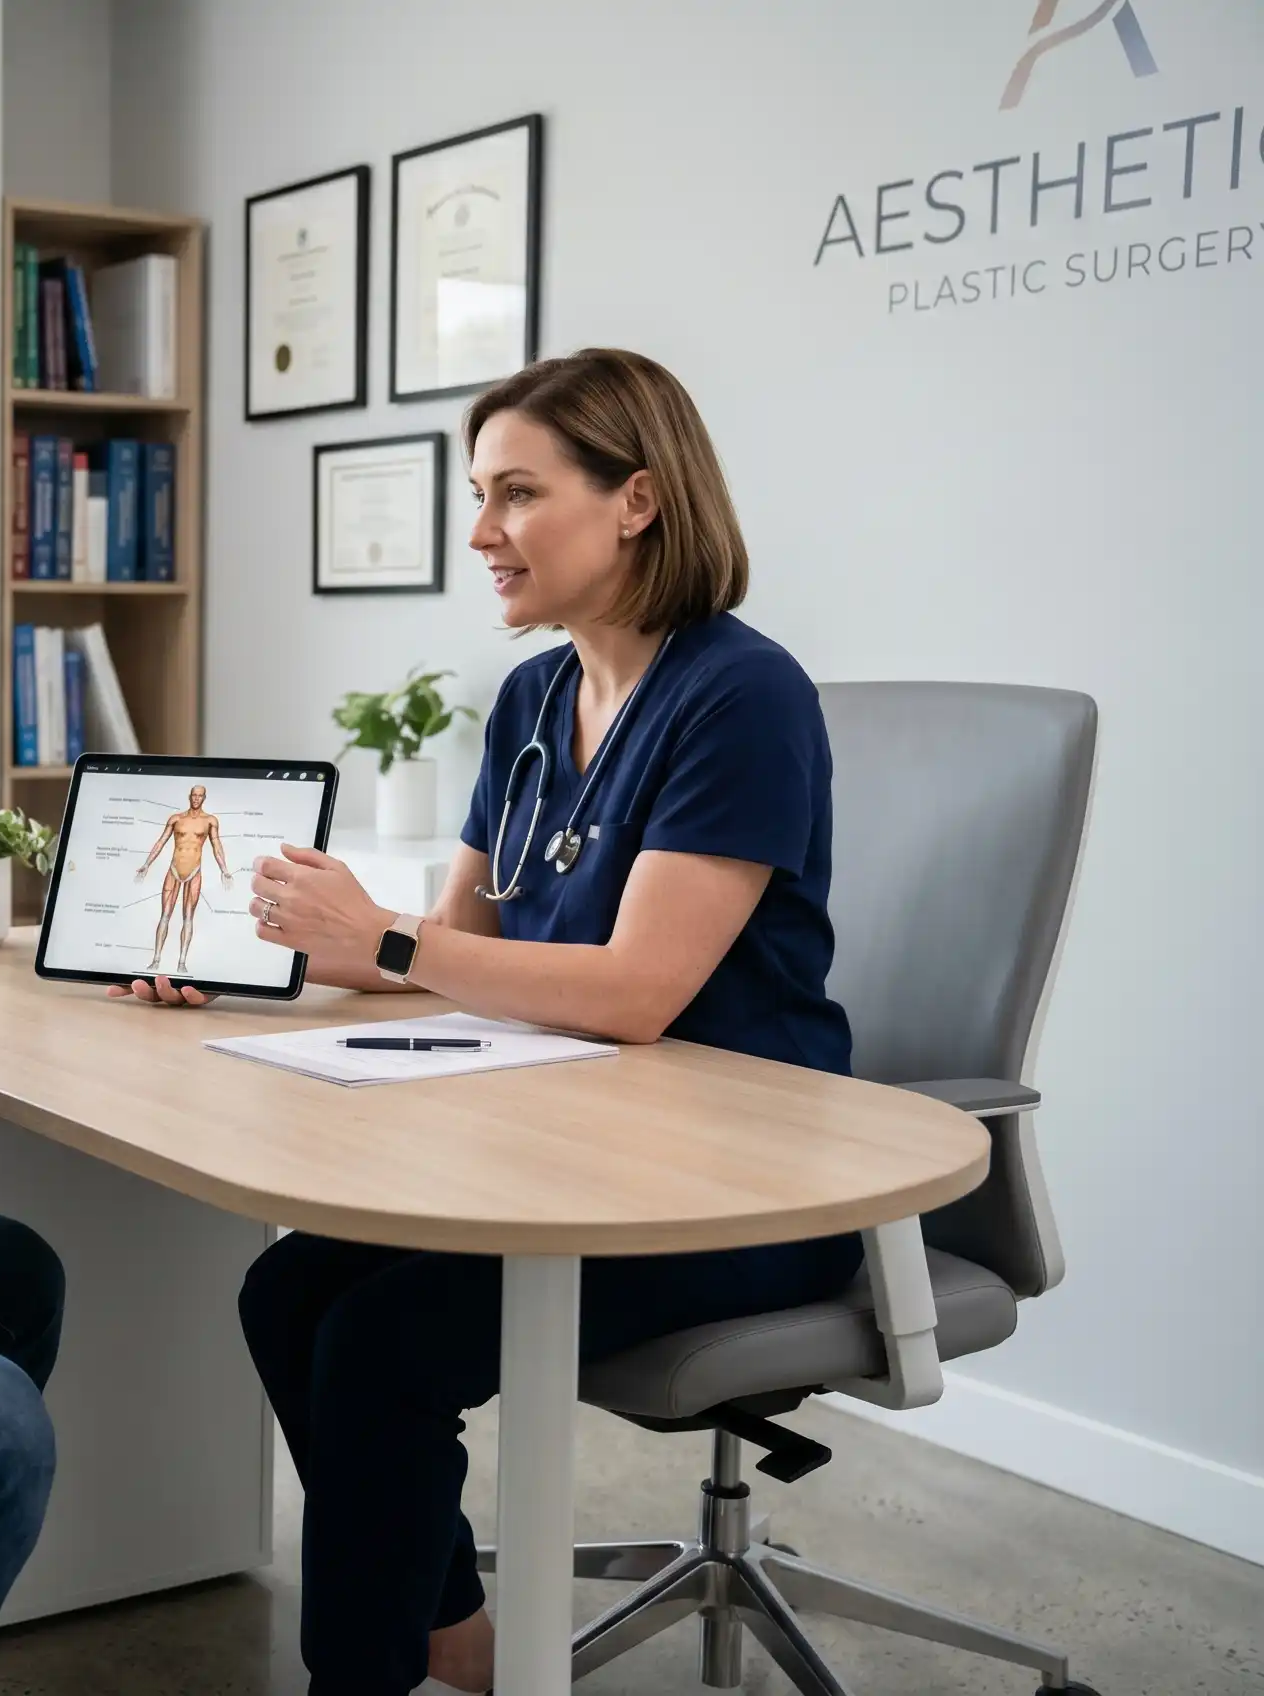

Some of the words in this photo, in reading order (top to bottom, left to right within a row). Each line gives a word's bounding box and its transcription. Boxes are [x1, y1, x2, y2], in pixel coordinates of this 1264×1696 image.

[813, 106, 1264, 267] AESTHETI
[888, 259, 1047, 314] PLASTIC
[1064, 222, 1264, 289] SURGER
